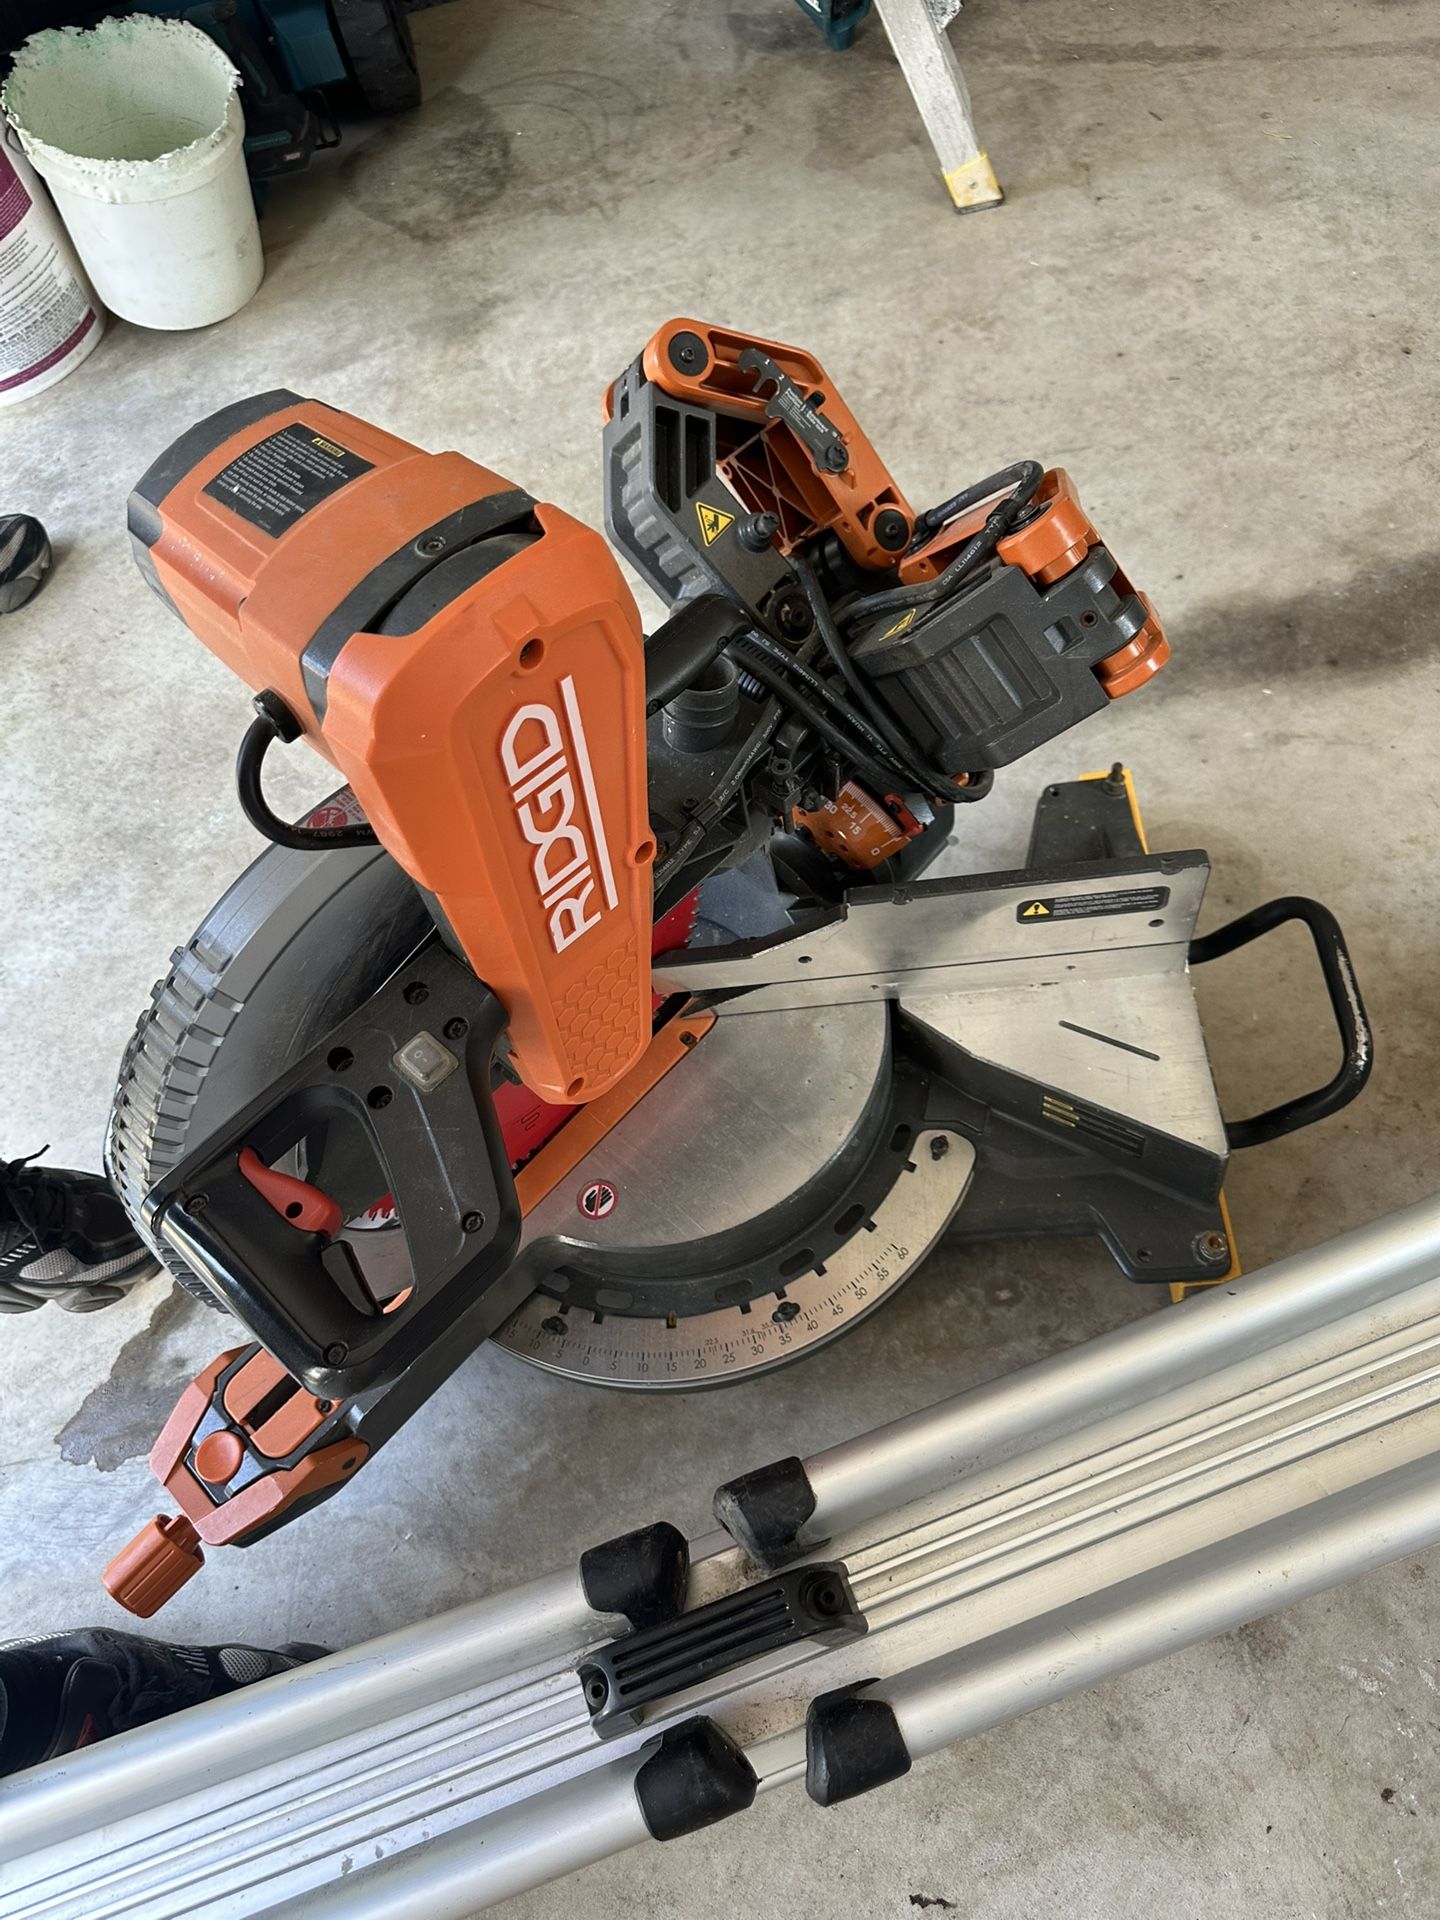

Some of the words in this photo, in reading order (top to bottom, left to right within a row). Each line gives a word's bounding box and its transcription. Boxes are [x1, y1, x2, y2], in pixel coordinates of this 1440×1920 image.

[824, 801, 838, 814] 30
[841, 803, 858, 818] 22.5
[501, 703, 602, 954] RIDGID
[849, 822, 862, 835] 15
[583, 1357, 590, 1365] 0
[610, 1361, 617, 1370] 5
[638, 1362, 649, 1372] 10
[666, 1362, 678, 1372] 15
[694, 1359, 707, 1370] 20
[723, 1353, 736, 1364] 25
[751, 1345, 764, 1356] 30
[779, 1334, 792, 1346] 35
[807, 1320, 819, 1332] 40
[832, 1305, 844, 1316] 45
[855, 1287, 868, 1300] 50
[877, 1268, 889, 1281] 55
[898, 1247, 909, 1260] 60
